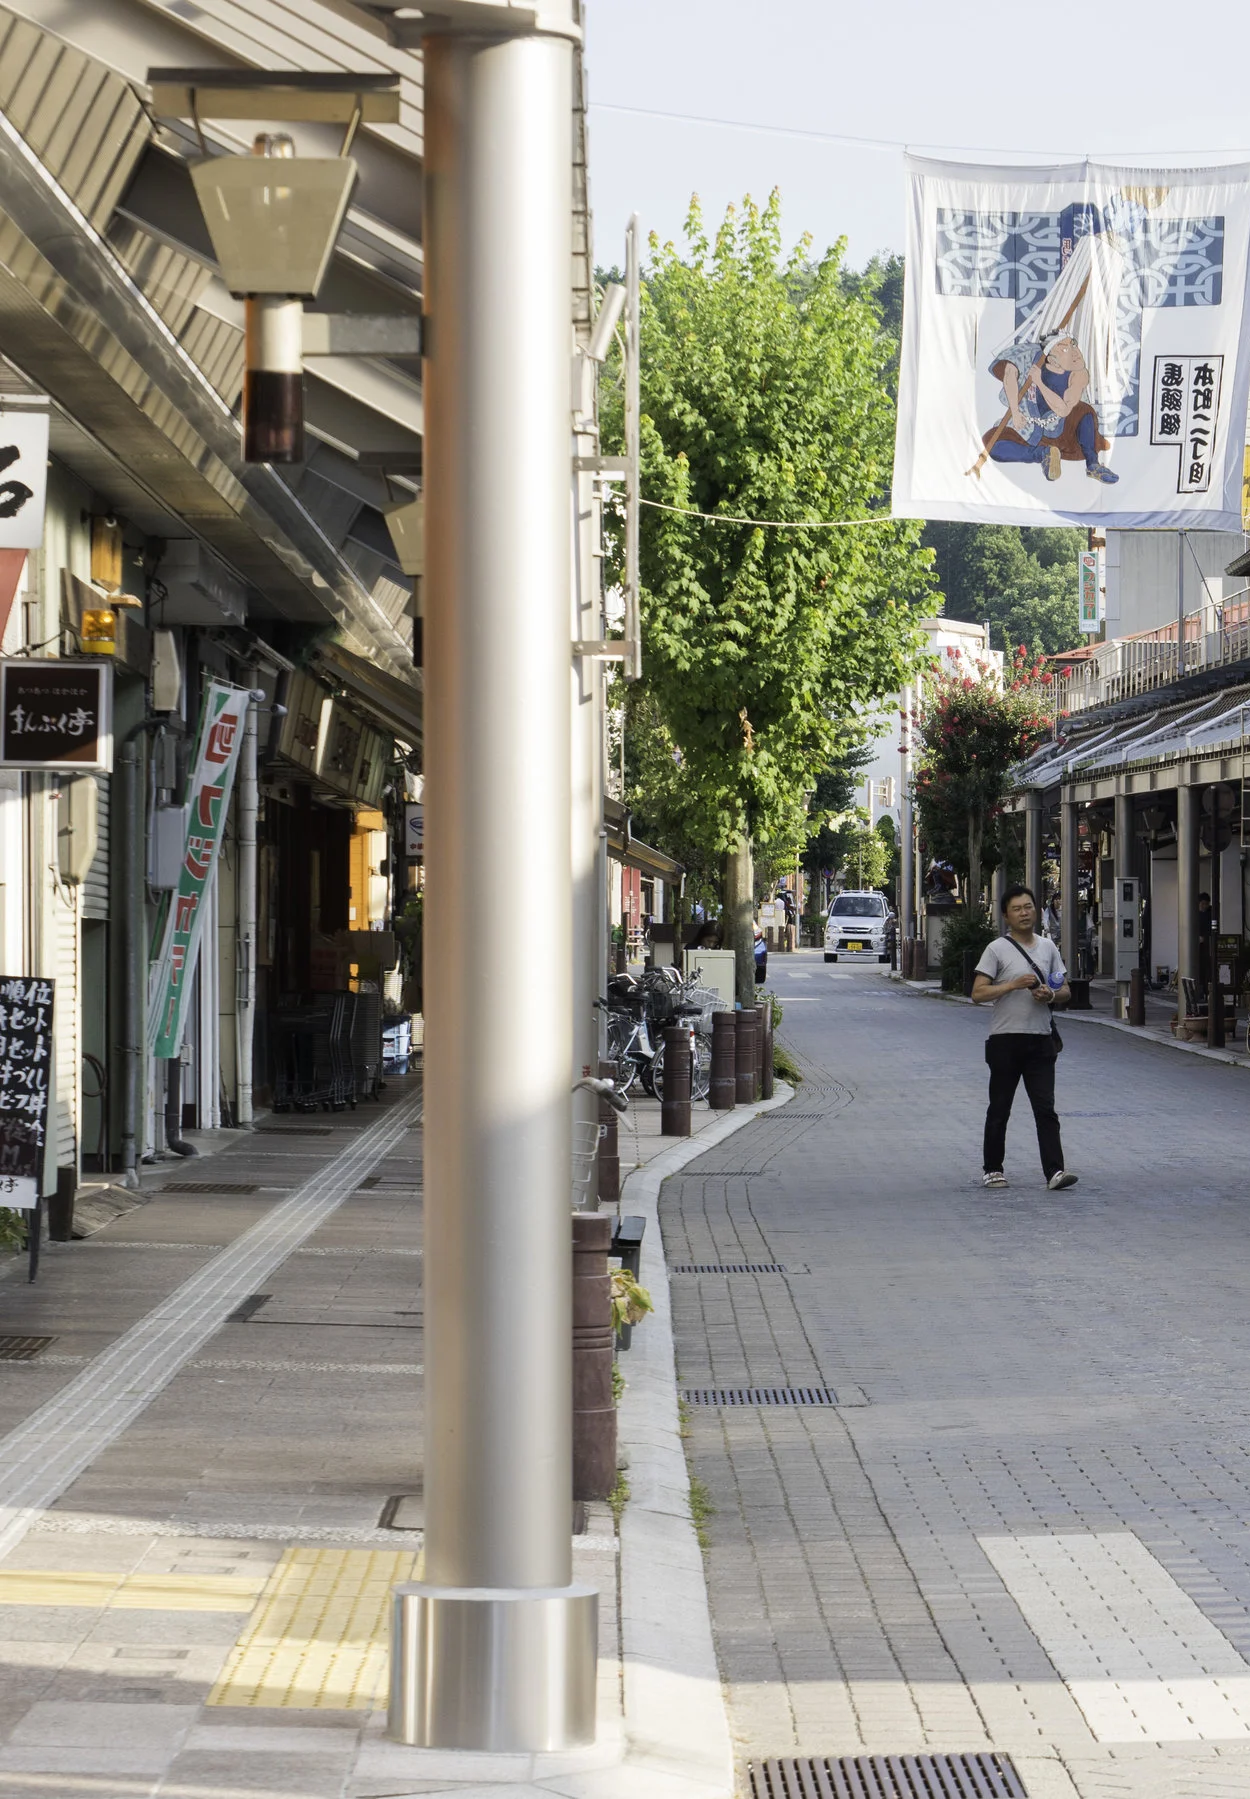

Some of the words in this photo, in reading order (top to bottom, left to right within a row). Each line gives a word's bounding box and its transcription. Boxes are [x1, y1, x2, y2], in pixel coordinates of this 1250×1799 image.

[1083, 571, 1096, 619] フジカラー
[9, 703, 95, 736] まんぷく亭
